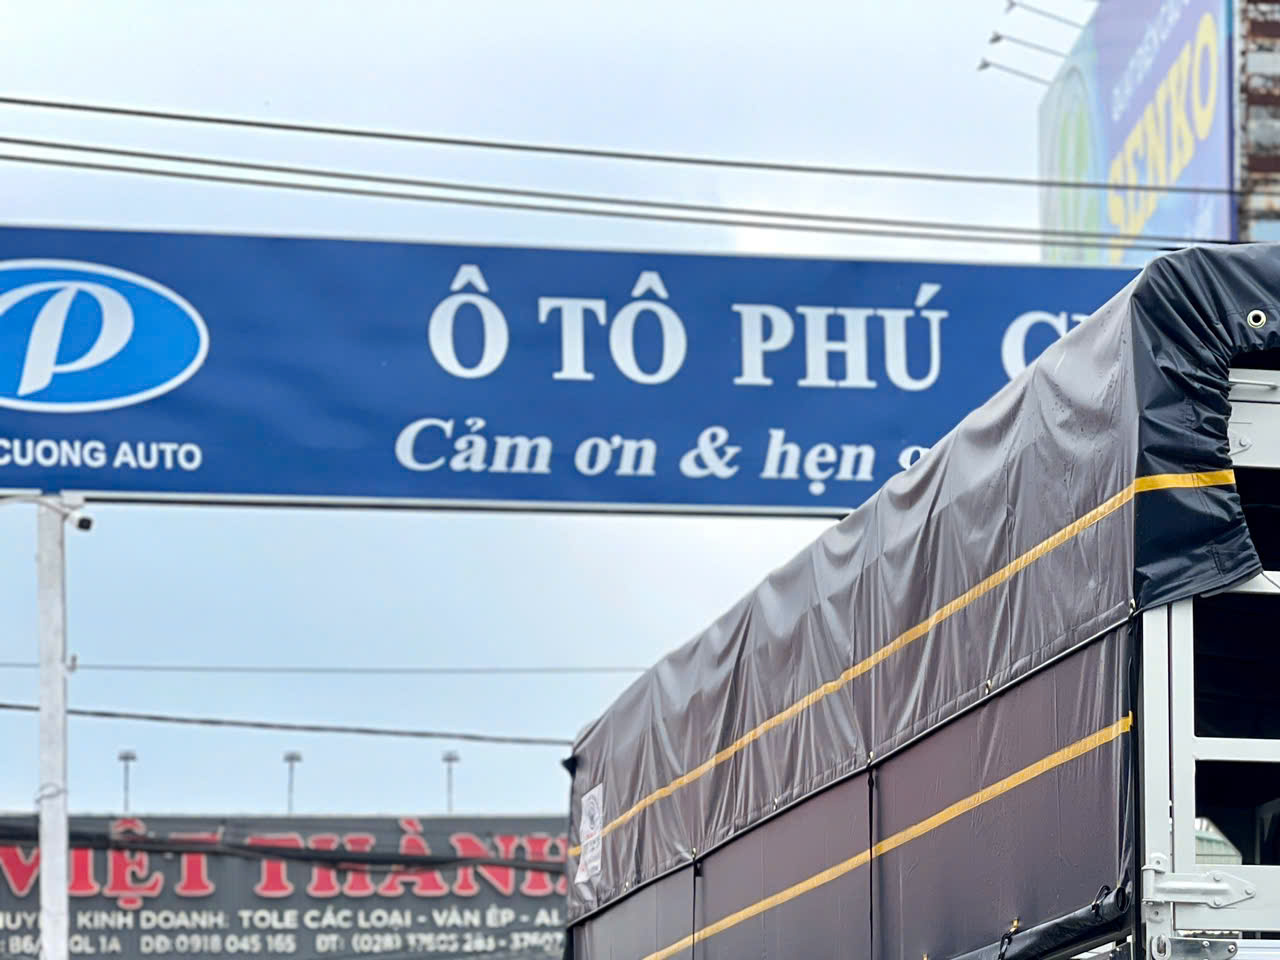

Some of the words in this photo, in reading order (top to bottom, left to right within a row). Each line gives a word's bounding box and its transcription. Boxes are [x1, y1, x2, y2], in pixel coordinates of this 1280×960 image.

[428, 264, 509, 378] Ô
[538, 271, 687, 385] TÔ
[731, 283, 949, 391] PHÚ
[113, 442, 203, 470] AUTO
[395, 417, 552, 474] Cảm
[574, 435, 657, 476] ơn
[679, 426, 741, 478] &
[760, 428, 875, 495] hẹn
[0, 817, 222, 909] VIỆT
[77, 910, 134, 929] KINH
[238, 910, 298, 930] TOLE
[304, 904, 353, 928] CÁC
[357, 908, 413, 931] LOẠI
